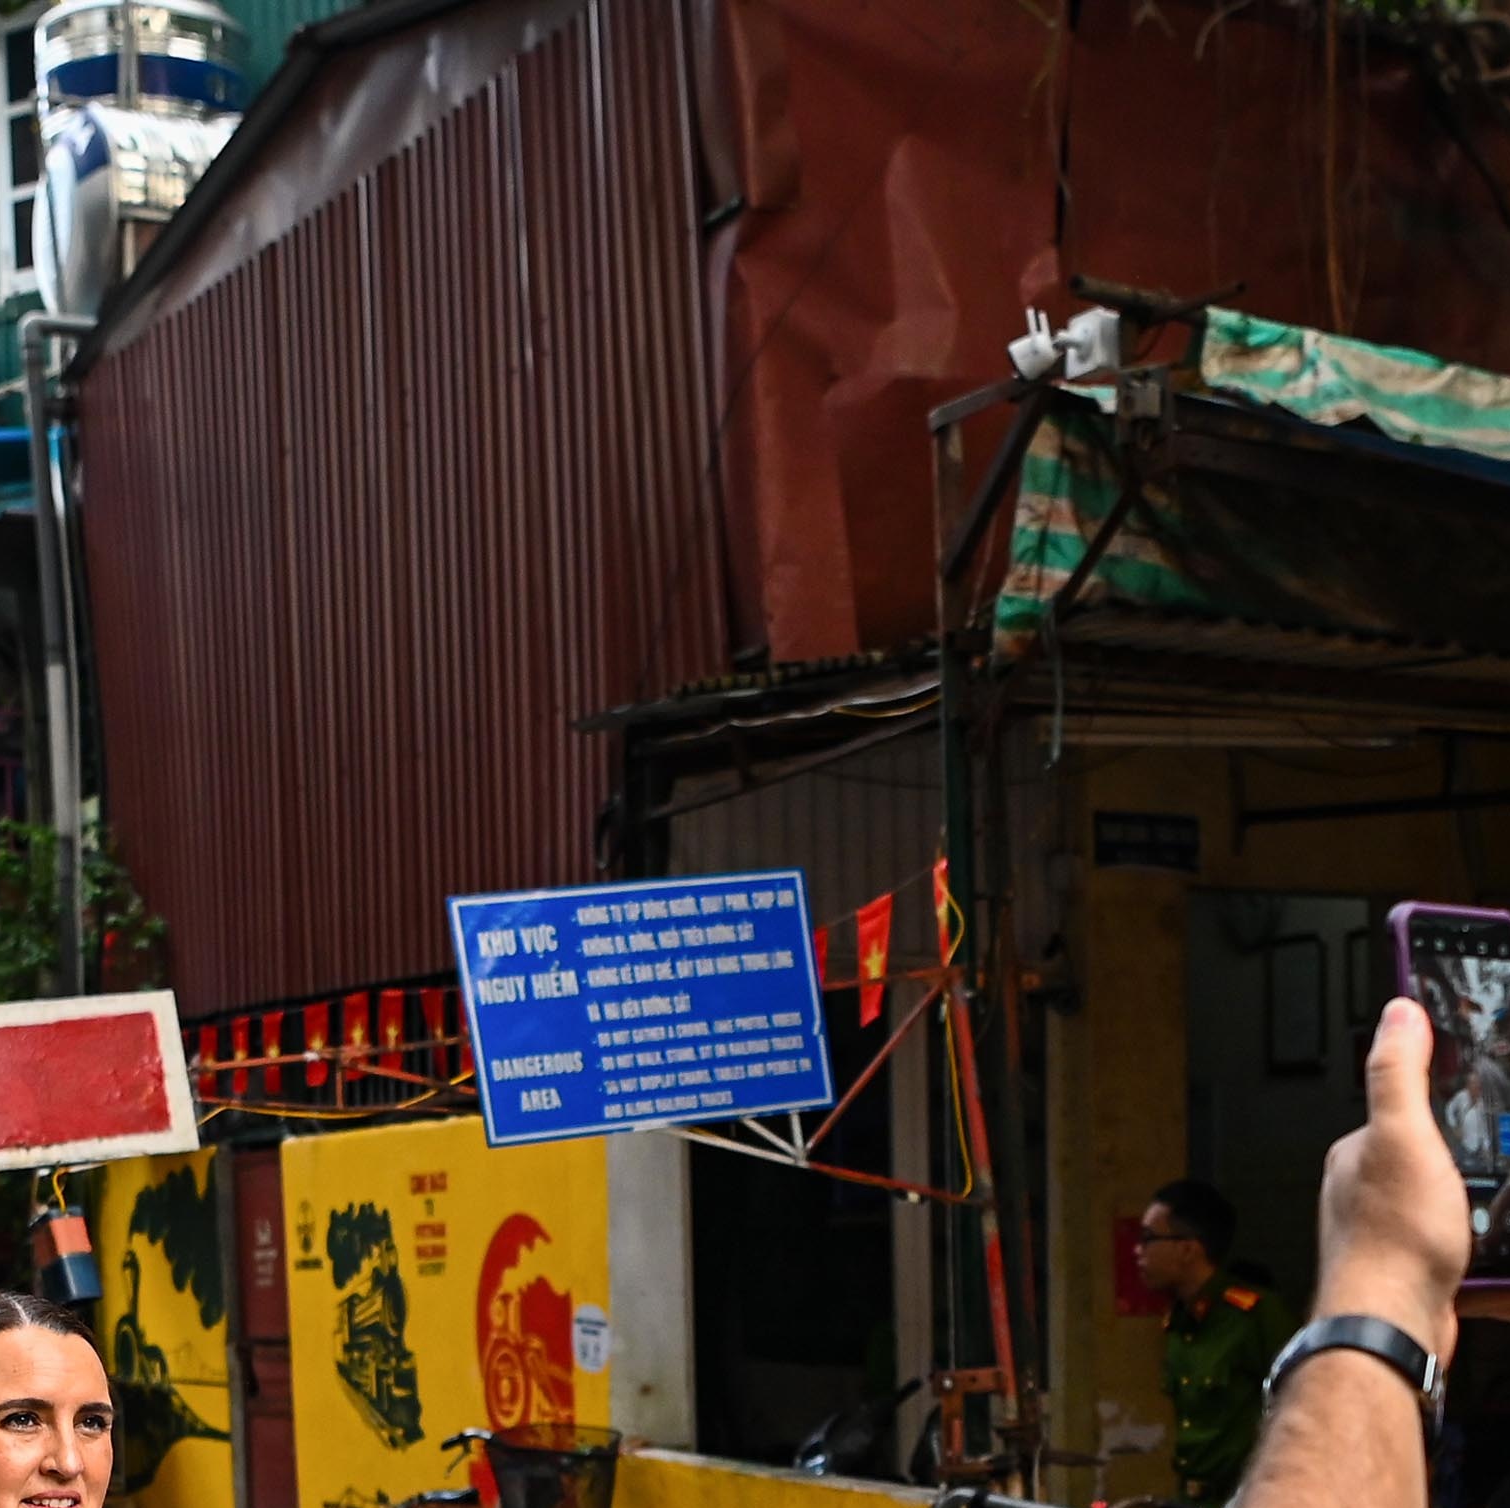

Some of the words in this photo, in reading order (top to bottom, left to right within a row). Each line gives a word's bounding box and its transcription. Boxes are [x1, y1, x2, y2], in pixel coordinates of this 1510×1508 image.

[477, 929, 517, 958] KHU
[477, 975, 526, 1005] NGUY
[491, 1051, 584, 1082] DANGEROUS
[520, 1088, 562, 1113] AREA
